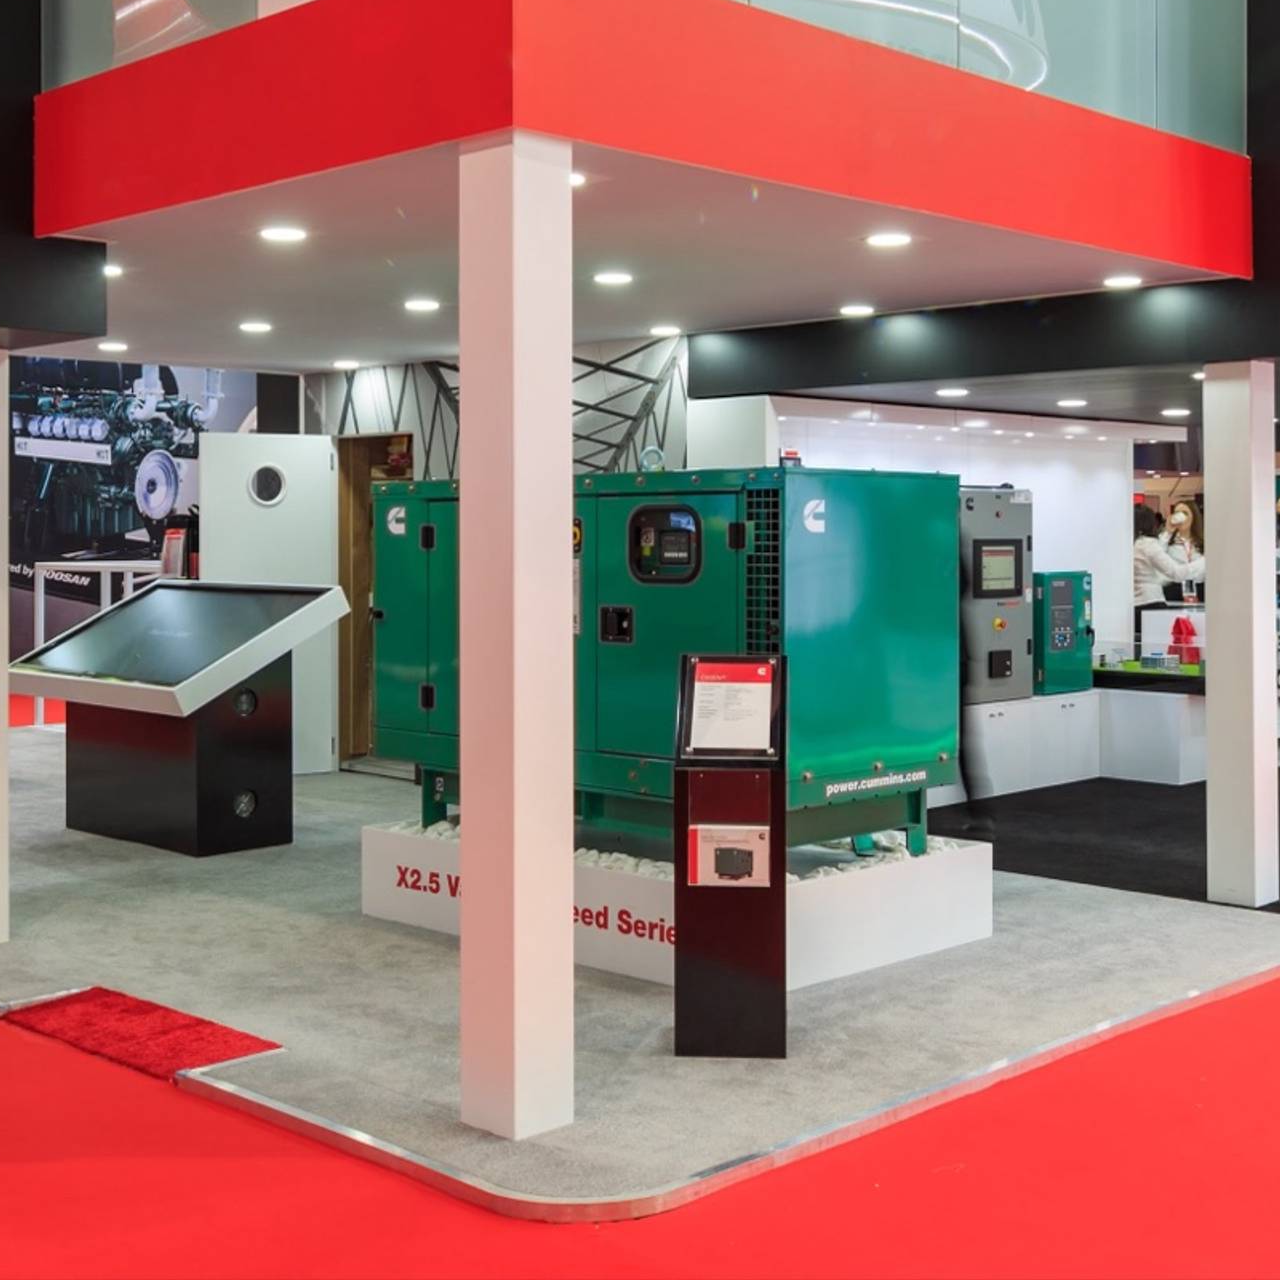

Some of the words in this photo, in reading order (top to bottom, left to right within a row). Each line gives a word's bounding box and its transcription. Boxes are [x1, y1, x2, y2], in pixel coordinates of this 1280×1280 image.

[22, 563, 35, 578] by
[825, 769, 927, 798] power.cummins.com
[396, 864, 441, 894] X2.5
[617, 907, 677, 945] Serie
